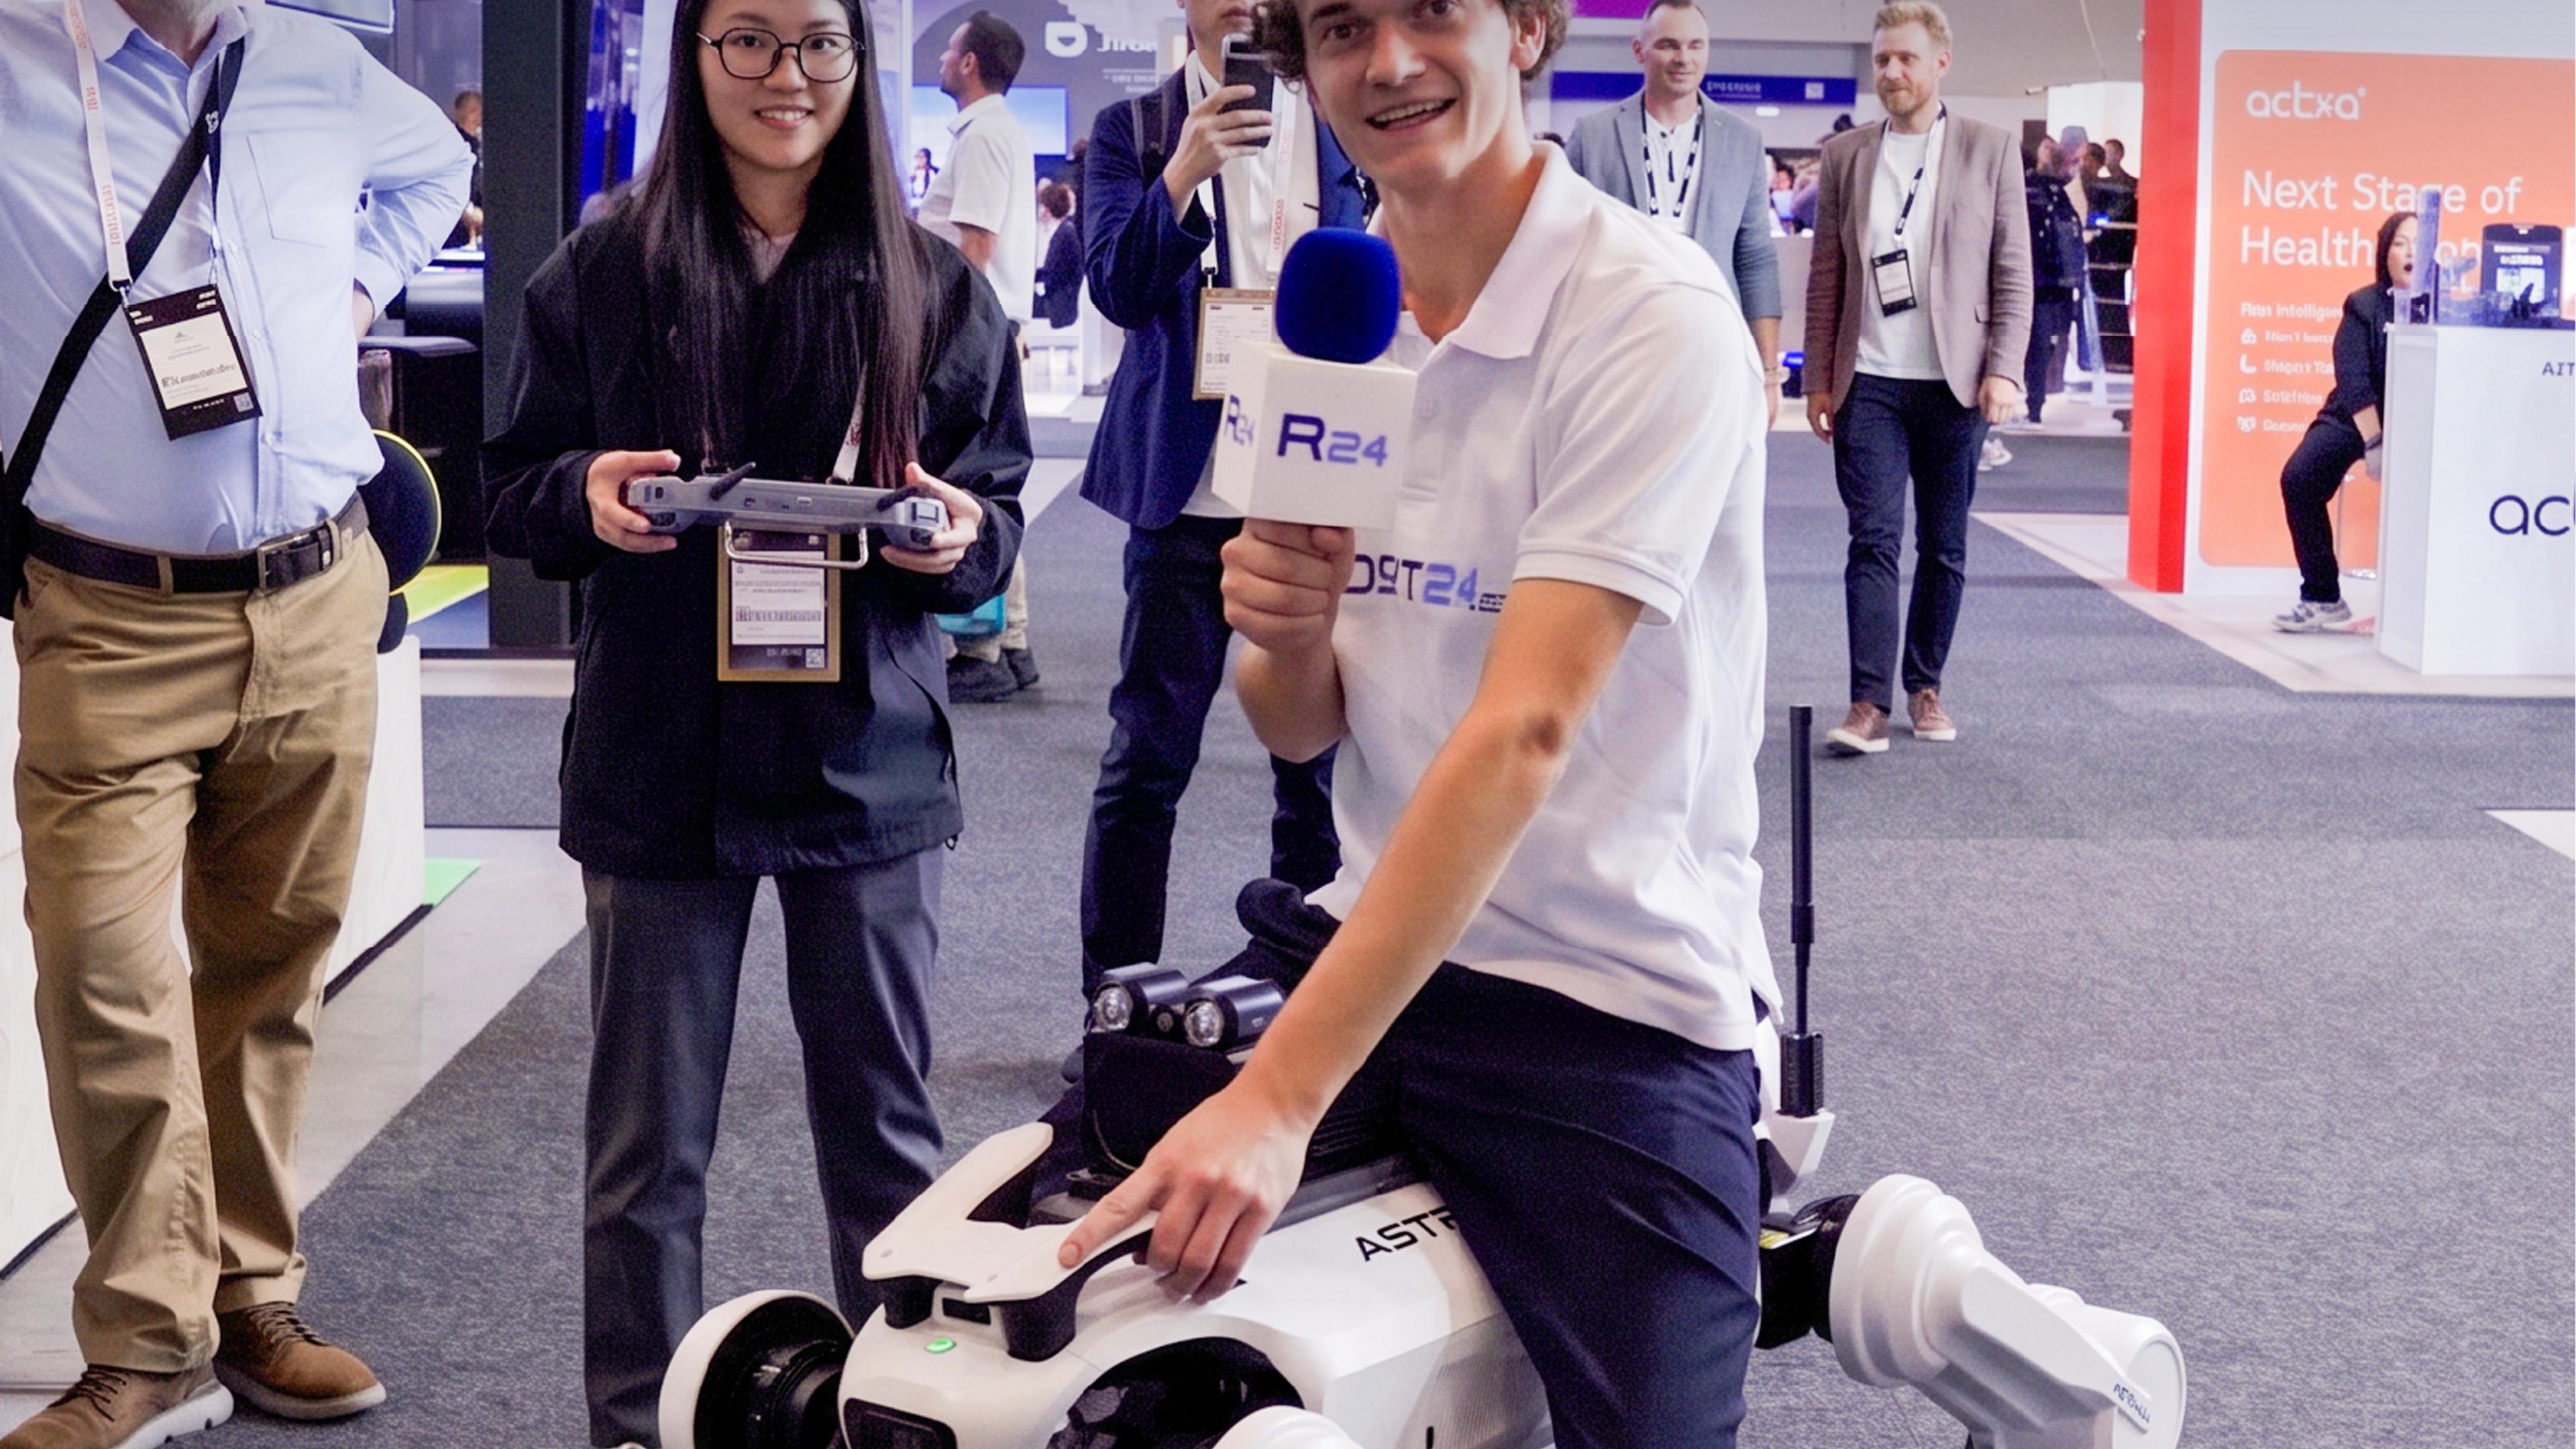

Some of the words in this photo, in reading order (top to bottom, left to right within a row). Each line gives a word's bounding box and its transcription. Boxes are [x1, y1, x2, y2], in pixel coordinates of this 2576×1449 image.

[2247, 80, 2360, 120] actxa
[2243, 170, 2338, 211] Next
[2480, 176, 2523, 214] of
[2241, 225, 2375, 268] Health
[1277, 413, 1387, 467] R24
[2489, 494, 2575, 536] ac
